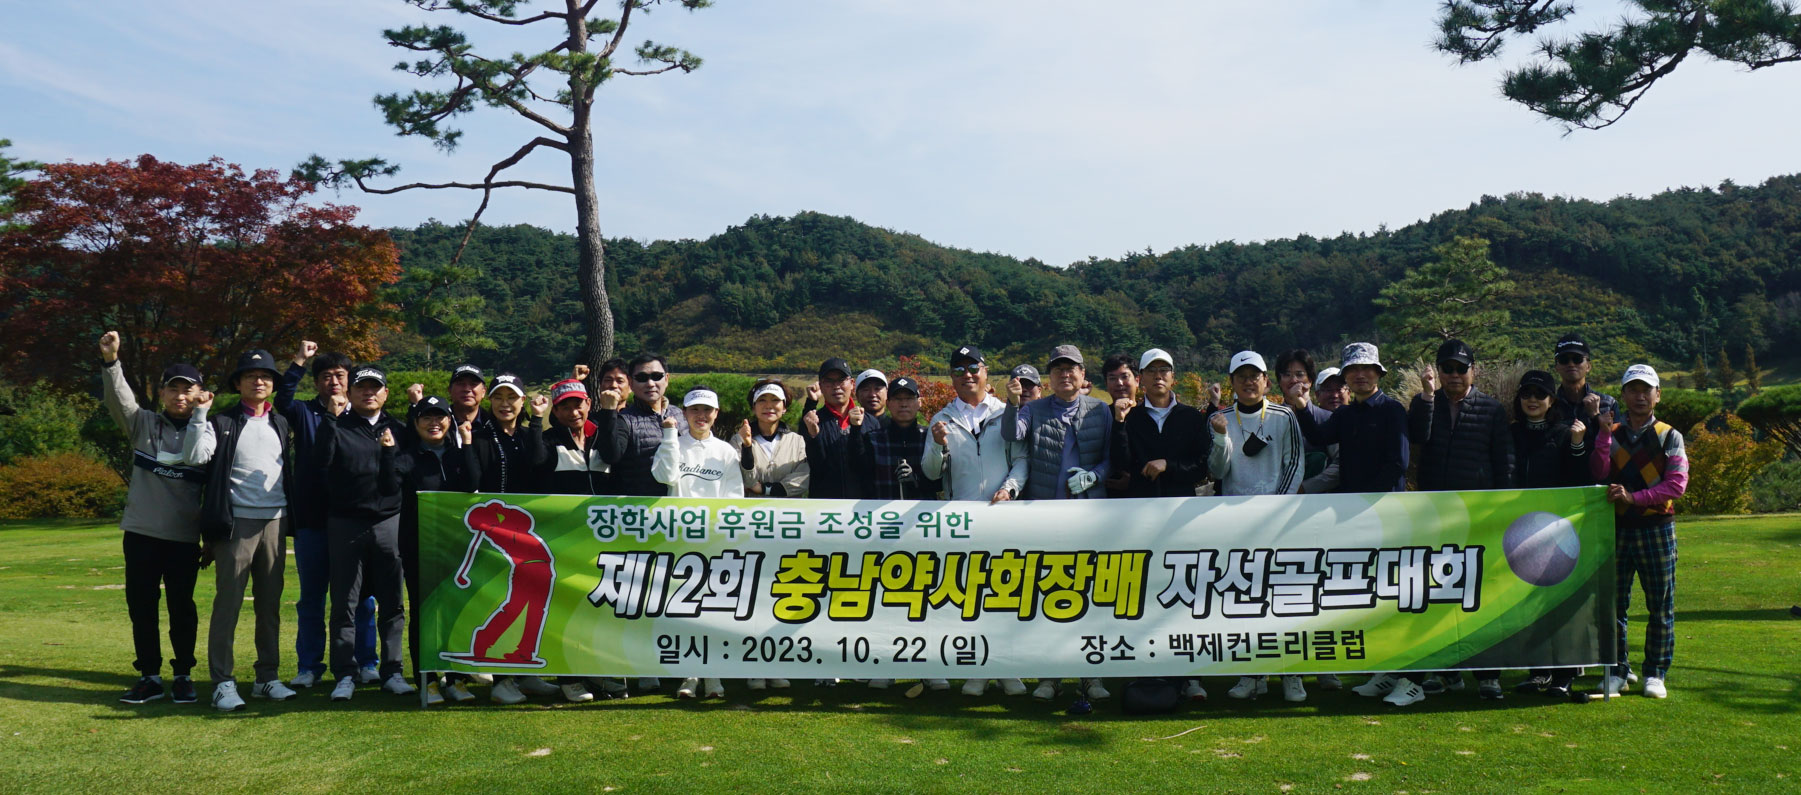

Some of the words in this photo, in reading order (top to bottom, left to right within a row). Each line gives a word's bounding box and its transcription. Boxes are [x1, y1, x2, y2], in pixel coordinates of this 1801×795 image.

[590, 508, 706, 539] 장학사업
[718, 509, 806, 539] 후원금
[816, 509, 904, 540] 조성을
[914, 510, 973, 540] 위한
[588, 550, 765, 621] 제12회
[771, 548, 1152, 623] 충남약사회장배
[1158, 543, 1486, 620] 자선골프대회
[656, 633, 709, 665] 일시
[742, 637, 823, 663] 2023.
[836, 637, 880, 665] 10.
[893, 637, 928, 664] 22
[939, 634, 991, 667] (일)
[1080, 634, 1137, 665] 장소
[1168, 630, 1367, 663] 백제컨트리클럽
